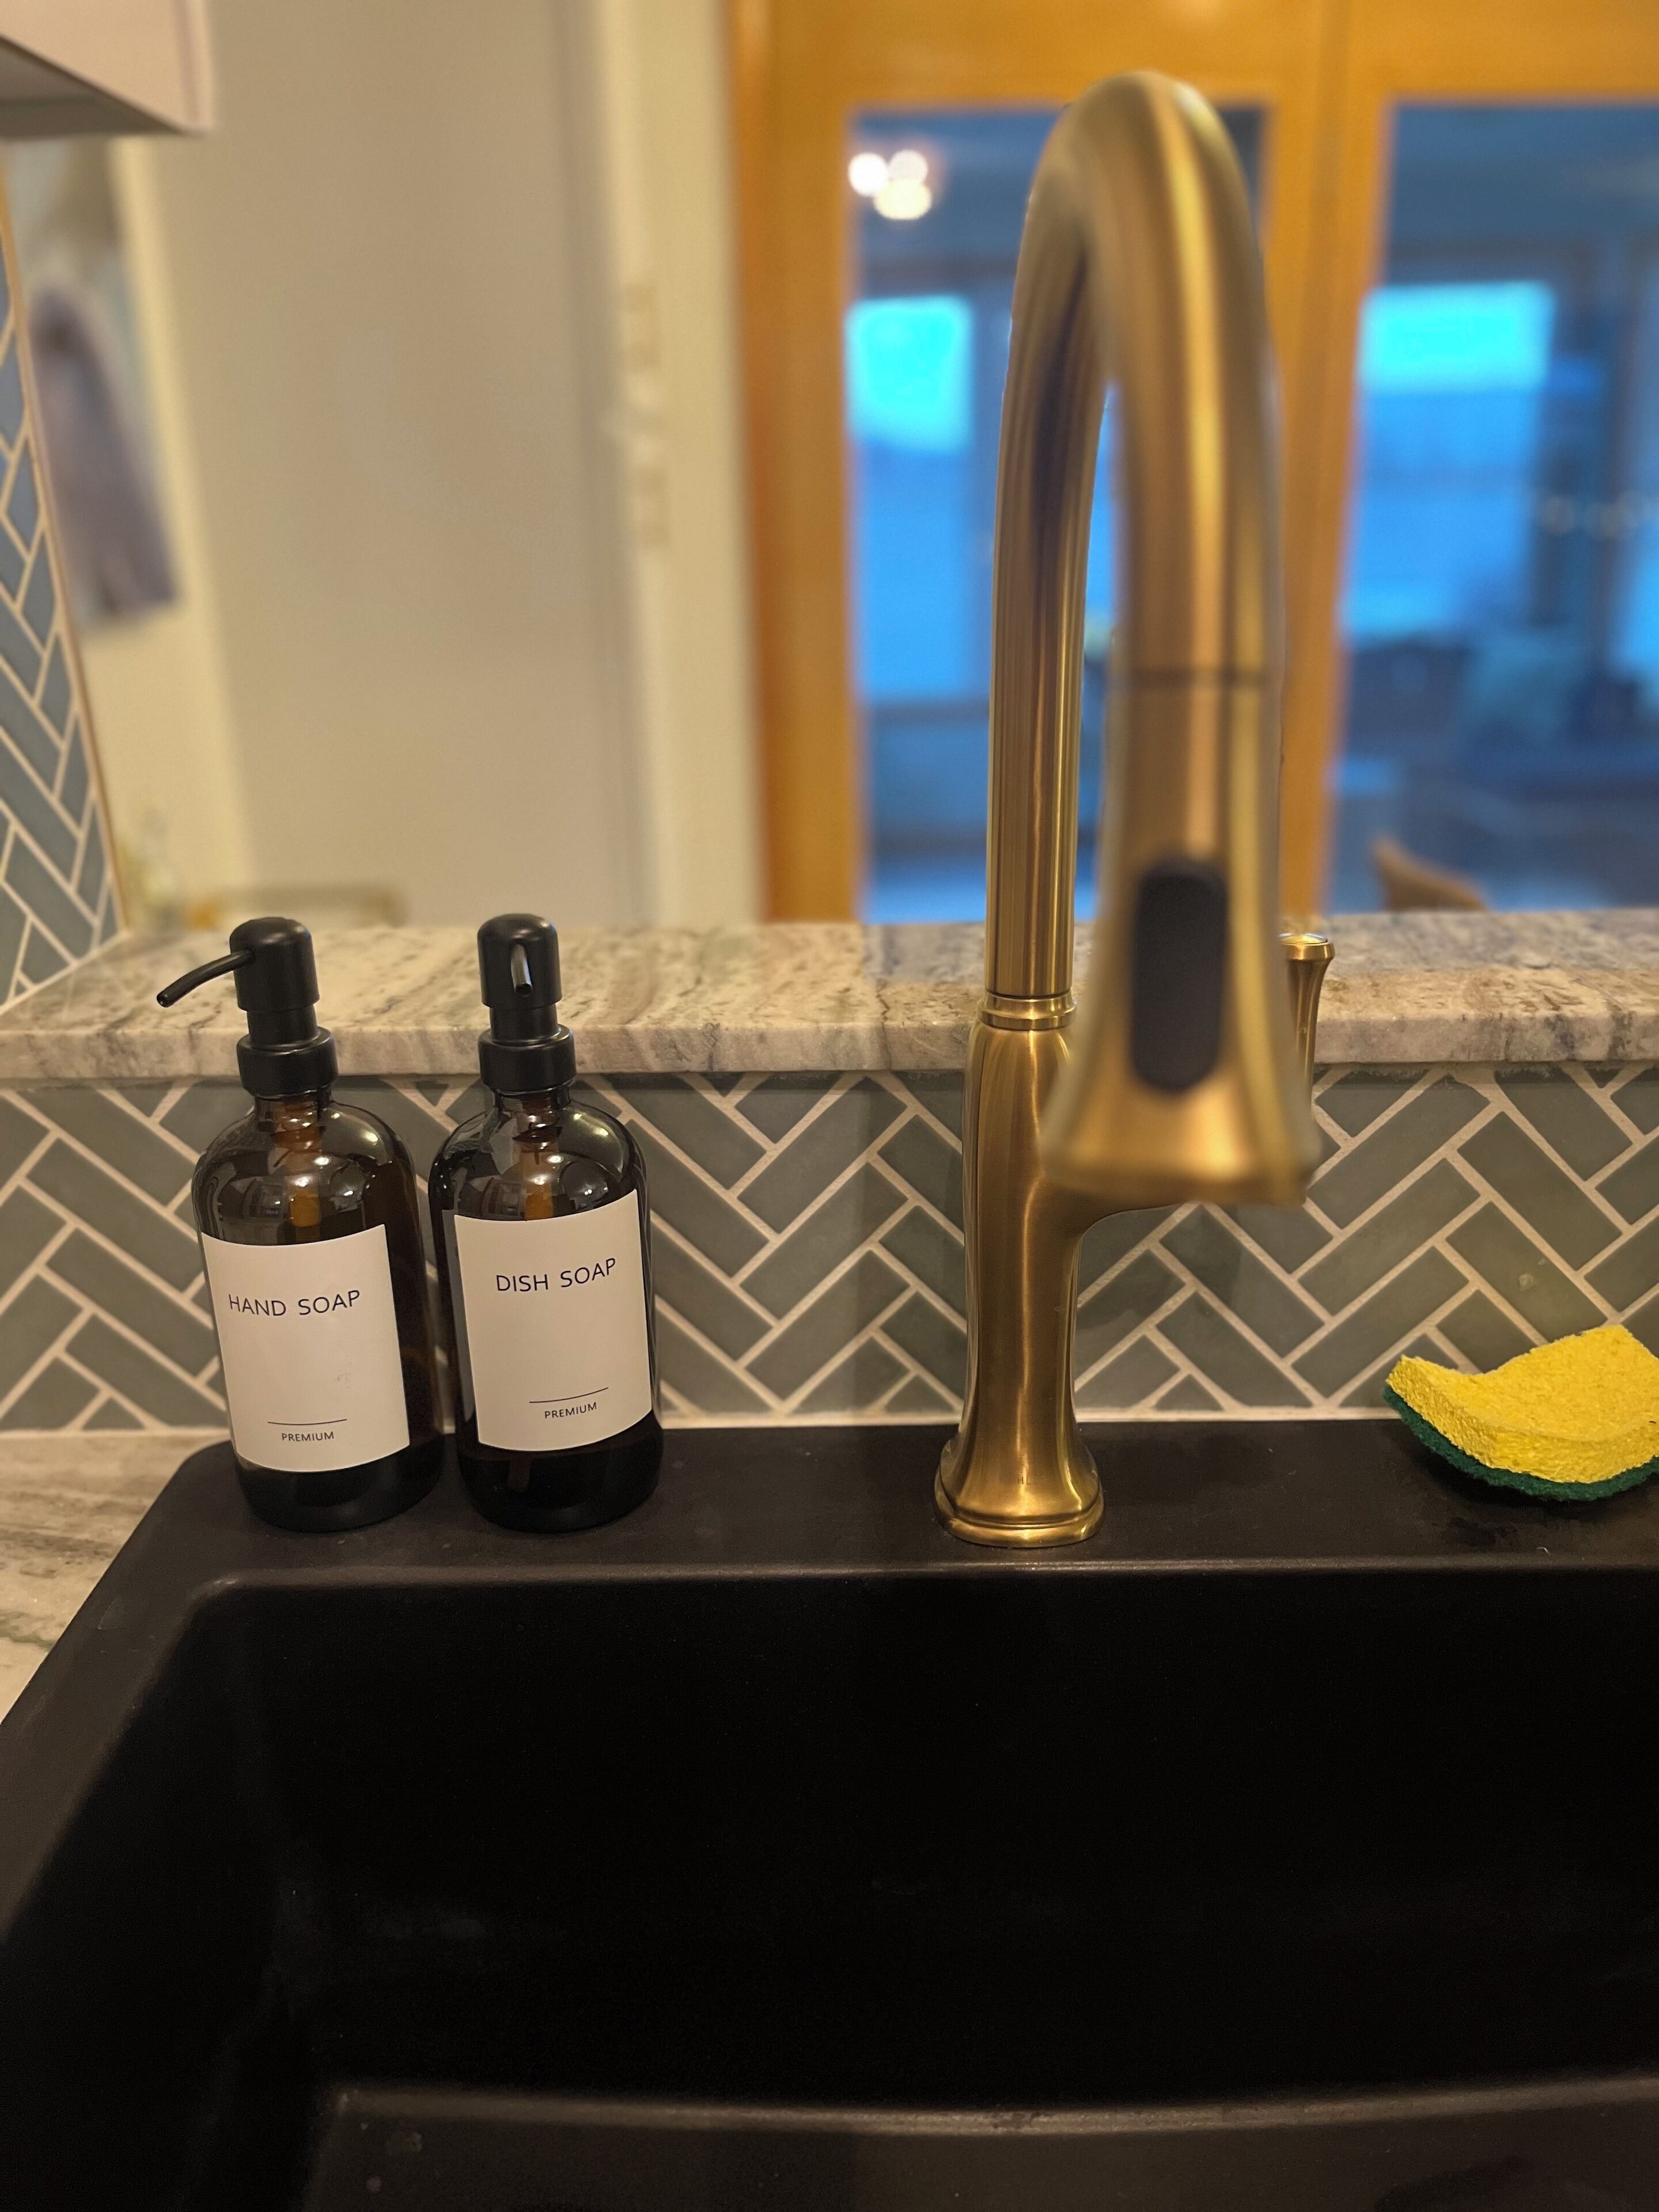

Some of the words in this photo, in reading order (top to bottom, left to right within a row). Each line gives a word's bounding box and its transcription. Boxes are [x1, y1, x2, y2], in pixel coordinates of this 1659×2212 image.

[496, 1274, 548, 1291] DISH
[560, 1257, 616, 1287] SOAP
[228, 1294, 287, 1316] HAND
[298, 1289, 361, 1315] SOAP
[544, 1402, 597, 1419] PREMIUM
[281, 1431, 335, 1441] PREMIUM
